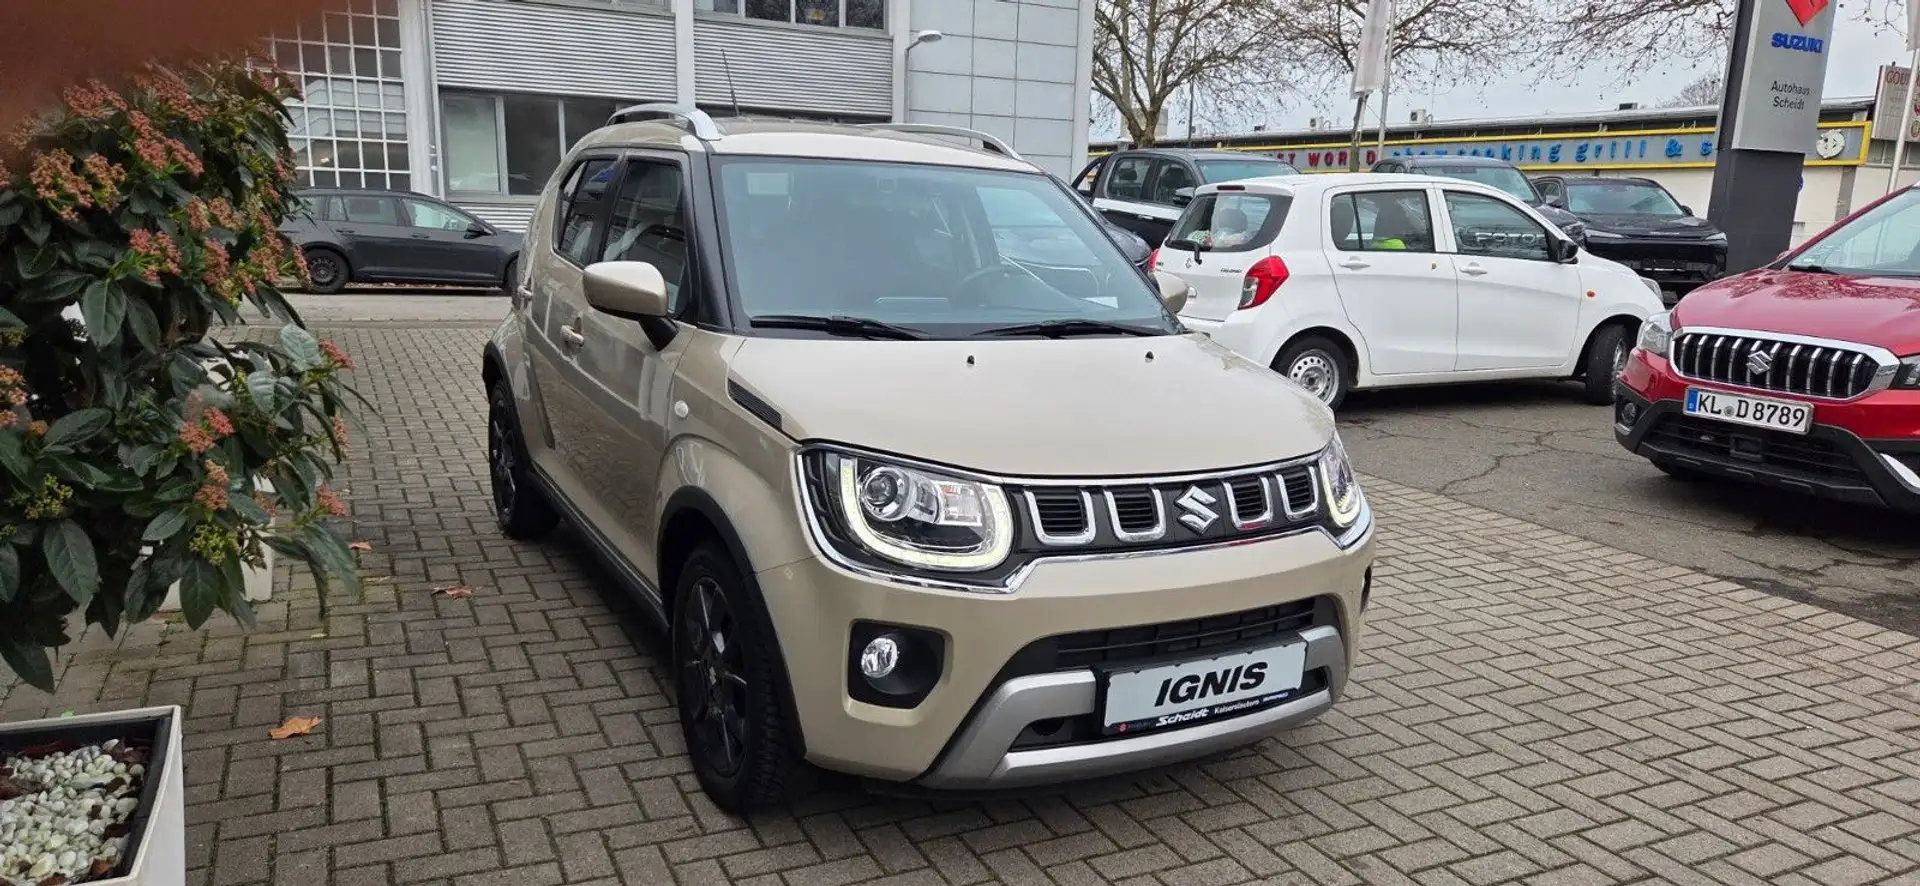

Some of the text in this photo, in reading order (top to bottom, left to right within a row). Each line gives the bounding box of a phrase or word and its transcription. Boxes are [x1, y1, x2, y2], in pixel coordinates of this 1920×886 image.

[1771, 32, 1824, 53] SUZUKI
[1771, 80, 1810, 96] Autohaus
[1773, 96, 1805, 110] Scheidt
[1308, 150, 1376, 168] WORD
[1575, 139, 1647, 163] grill
[1698, 394, 1722, 415] KL
[1753, 402, 1805, 427] 8789
[1154, 661, 1268, 708] IGNIS
[1156, 708, 1209, 727] Scheidt
